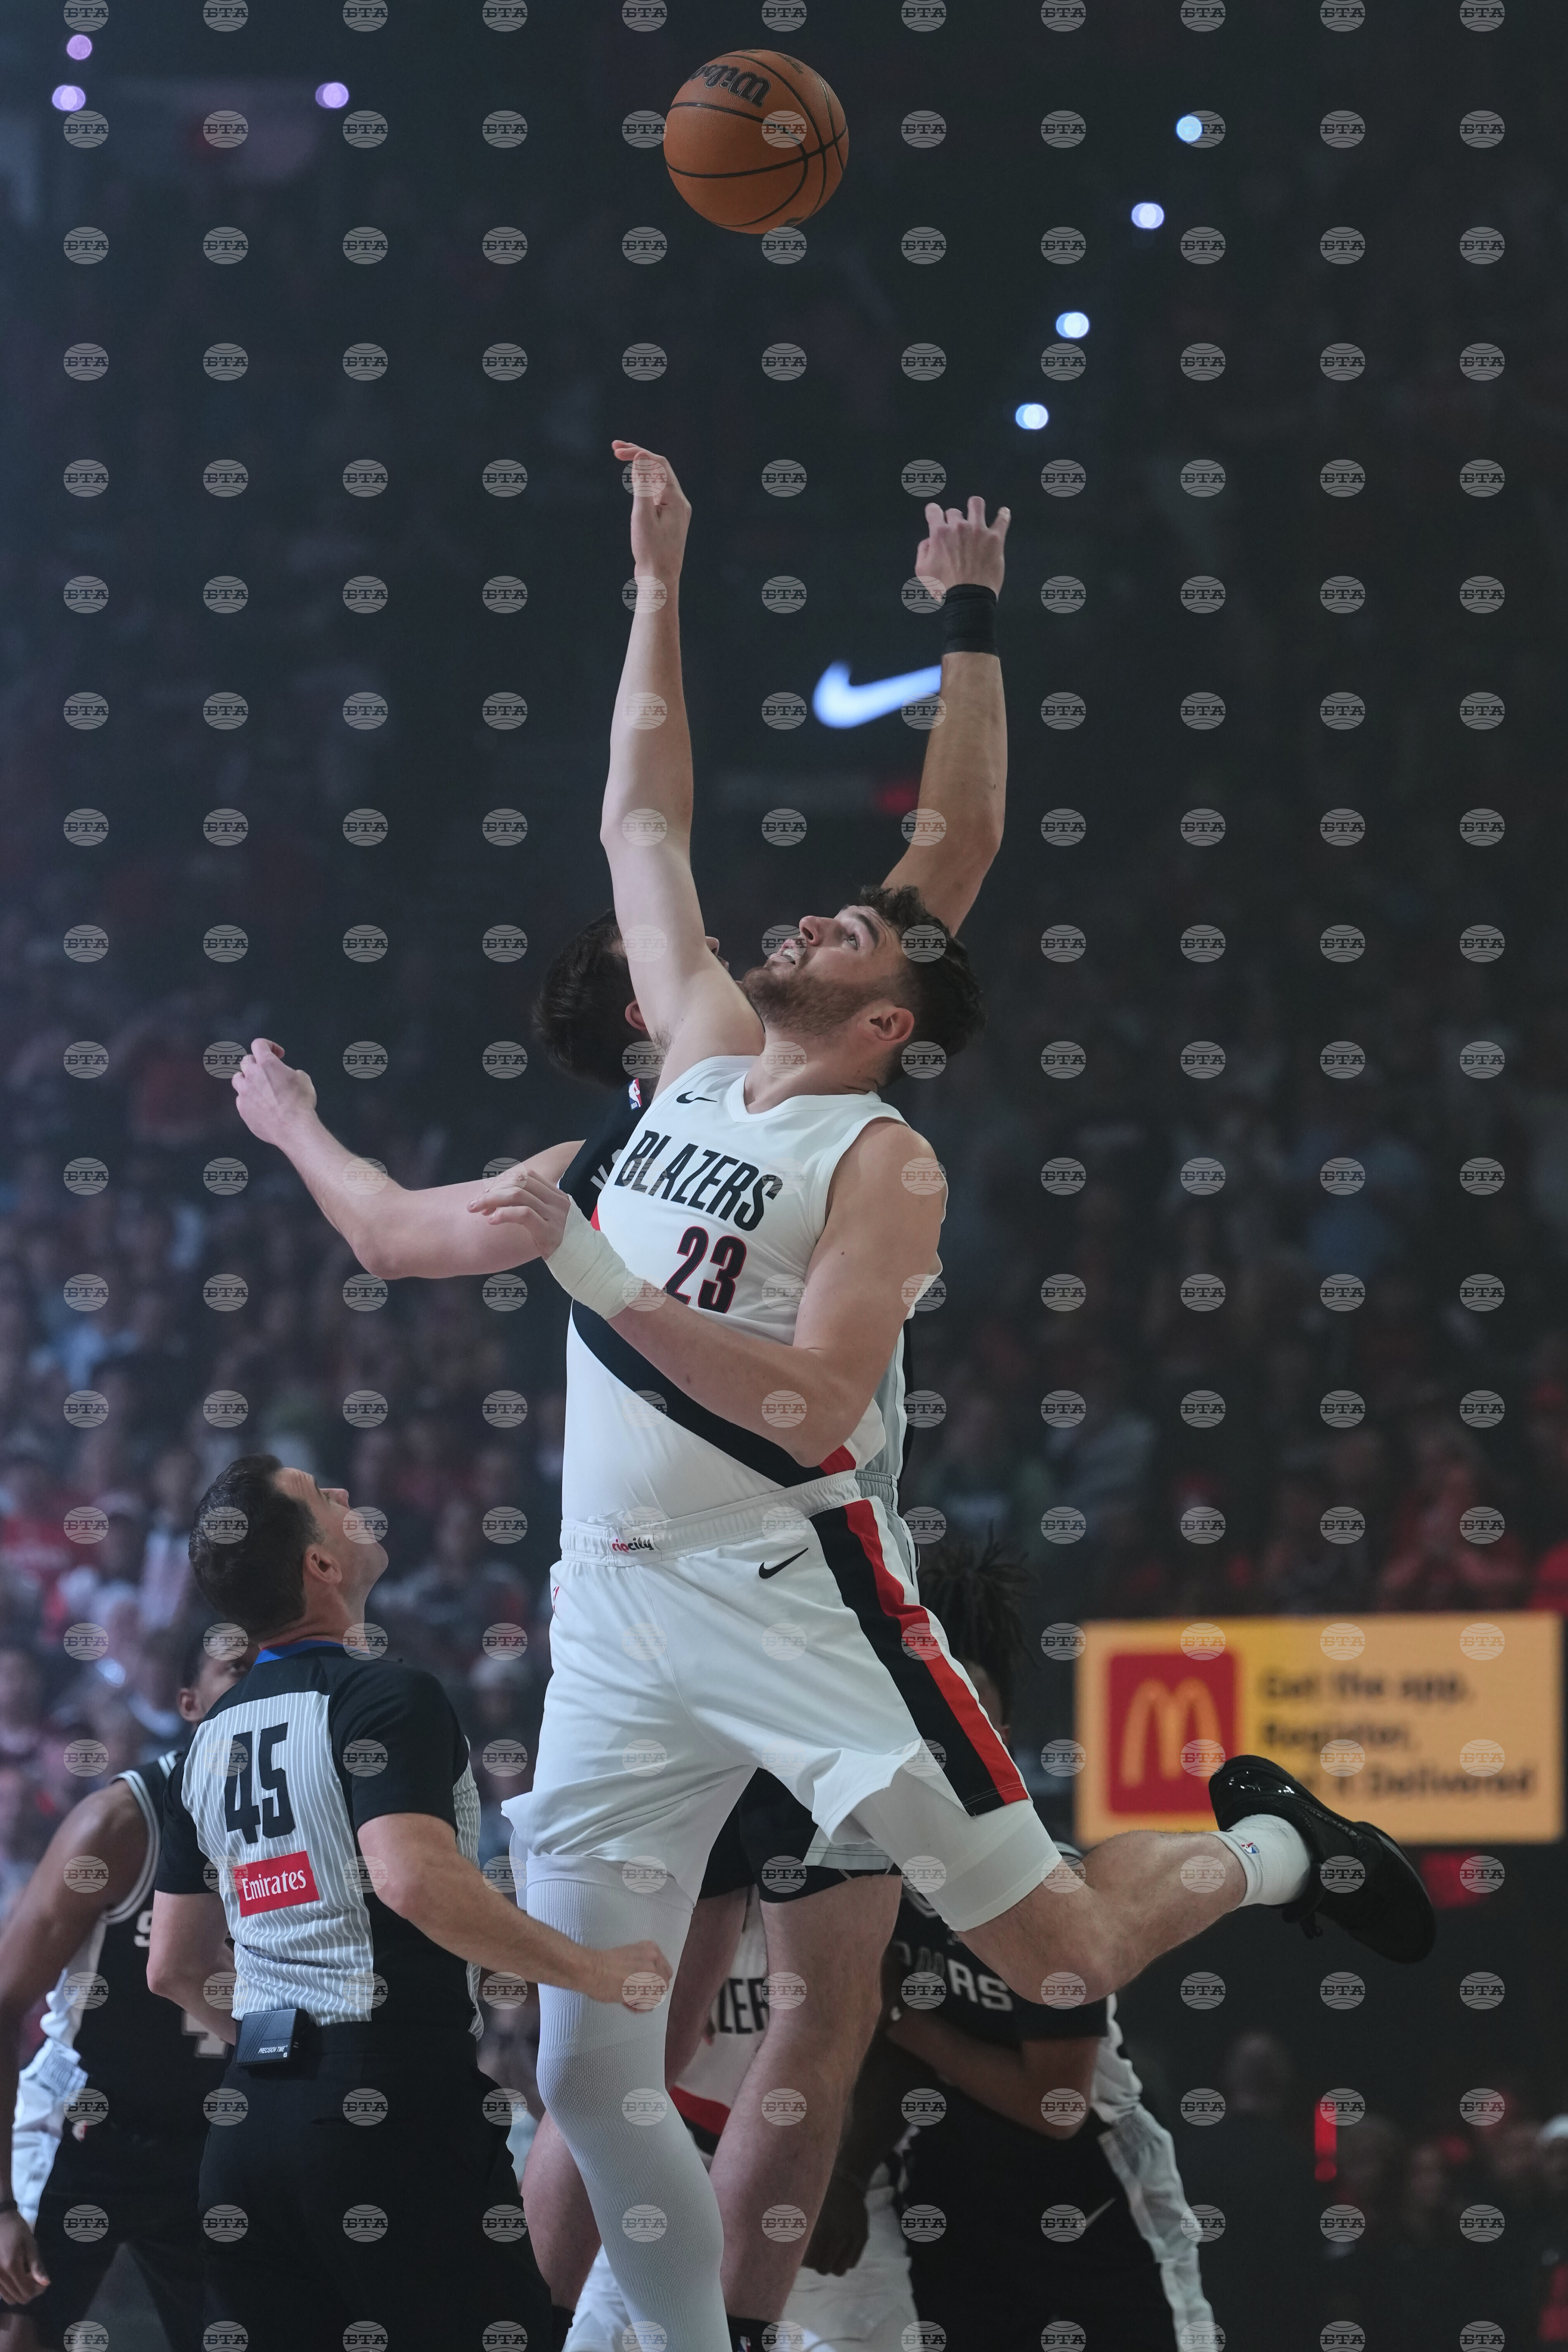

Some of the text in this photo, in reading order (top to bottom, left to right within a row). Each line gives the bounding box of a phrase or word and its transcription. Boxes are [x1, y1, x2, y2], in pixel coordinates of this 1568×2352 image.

[614, 1130, 783, 1231] BLAZERS
[662, 1226, 747, 1313] 23
[224, 1722, 296, 1844] 45
[242, 1870, 306, 1901] Emirates
